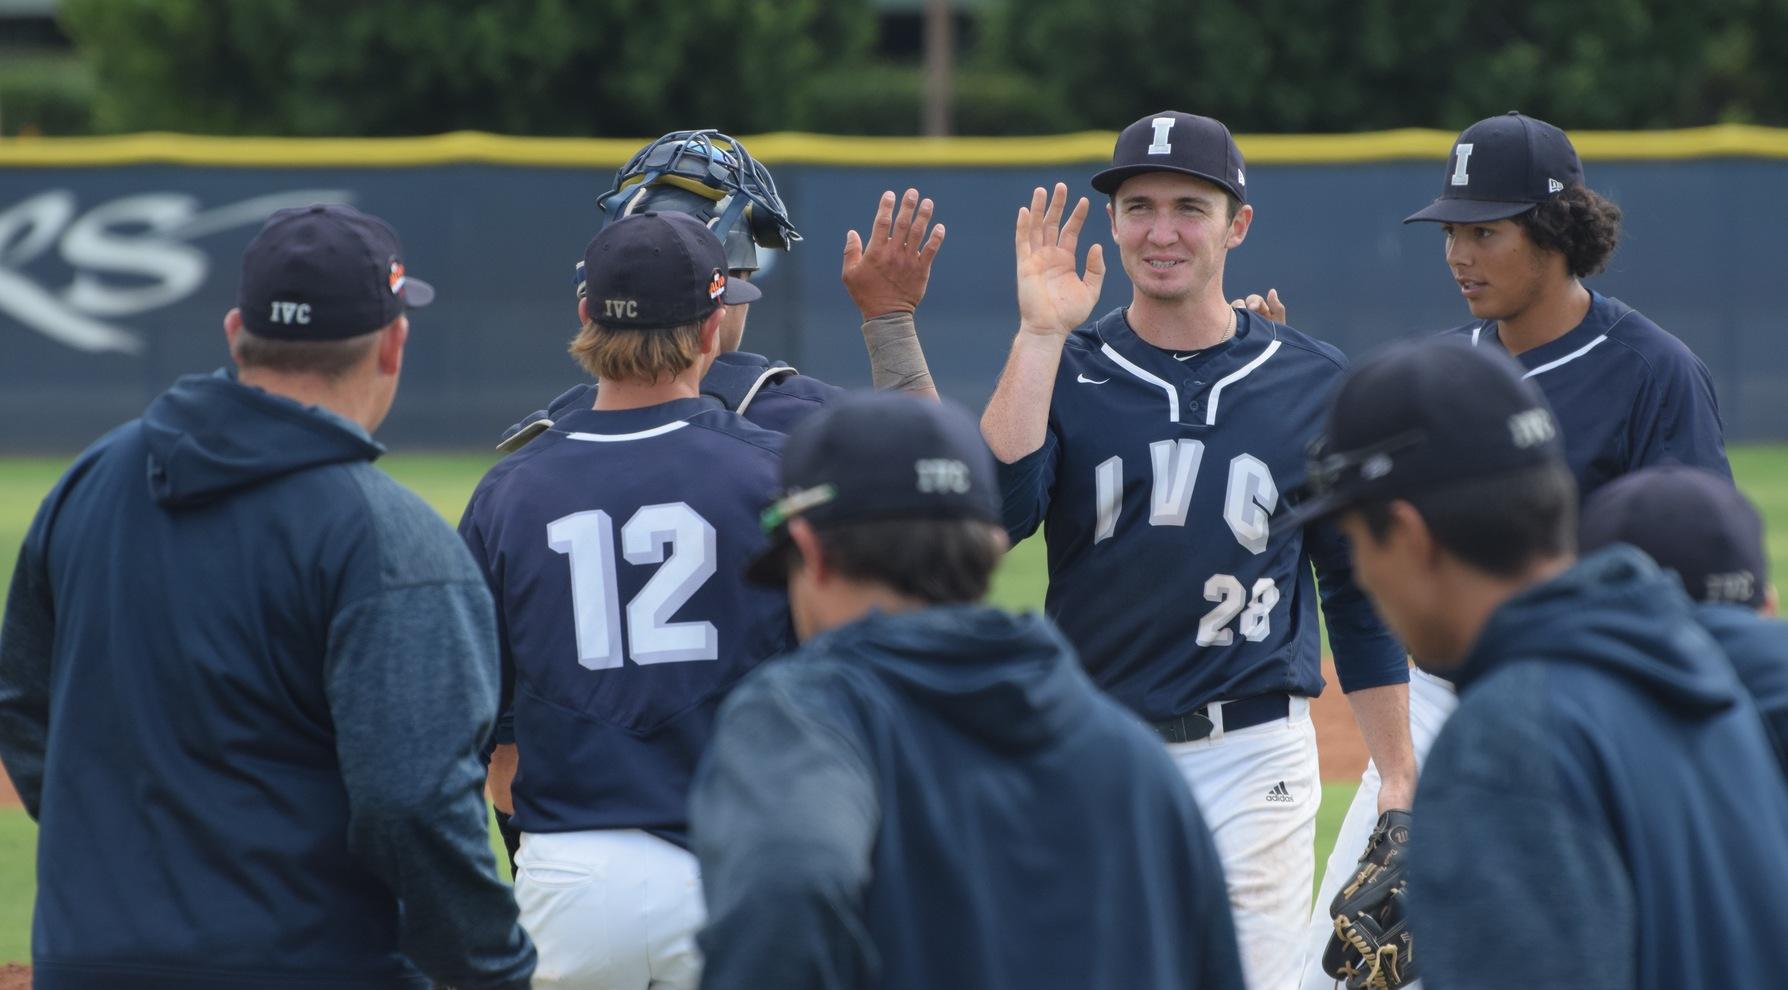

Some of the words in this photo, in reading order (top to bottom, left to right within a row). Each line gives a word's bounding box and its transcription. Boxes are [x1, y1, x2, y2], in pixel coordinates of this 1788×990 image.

[1148, 117, 1176, 155] I
[1451, 143, 1474, 186] I
[270, 301, 311, 324] IVC
[604, 299, 638, 319] IVC
[546, 501, 718, 671] 12
[1195, 573, 1280, 647] 28
[1266, 794, 1294, 802] adidas
